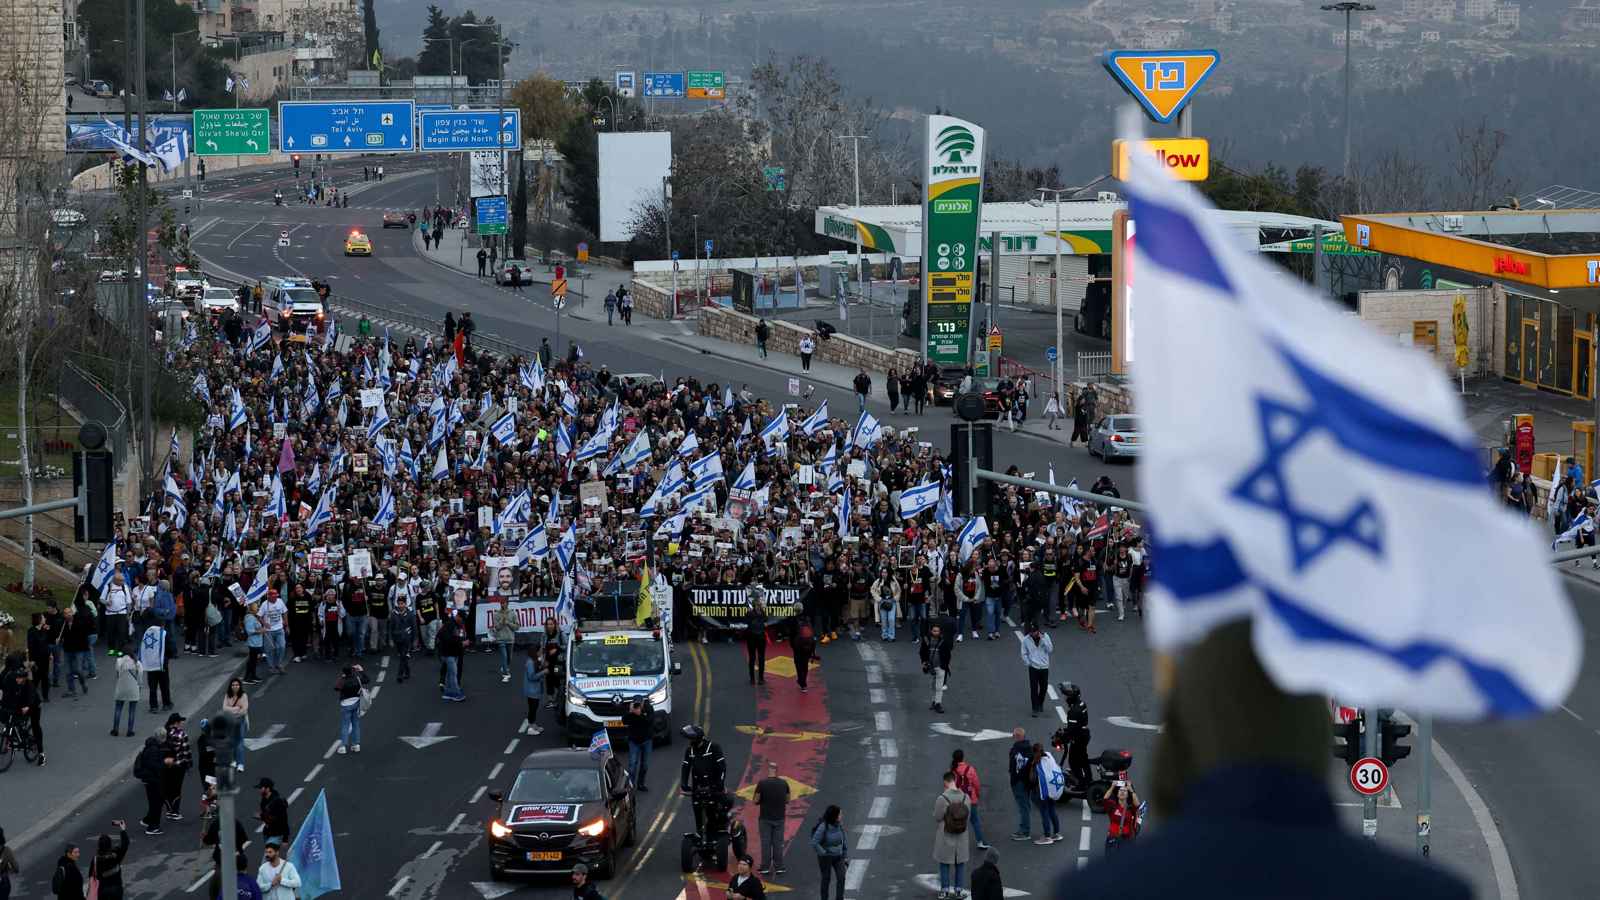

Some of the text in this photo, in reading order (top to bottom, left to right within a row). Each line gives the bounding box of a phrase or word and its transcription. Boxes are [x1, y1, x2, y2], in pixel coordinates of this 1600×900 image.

[1142, 61, 1185, 90] פז
[427, 136, 449, 144] Begin
[471, 135, 493, 143] North
[932, 164, 978, 175] דור אלון
[938, 201, 969, 211] אלונית
[1001, 236, 1037, 250] דור
[691, 589, 719, 604] ביחד
[763, 589, 800, 604] ישראל
[692, 605, 728, 617] החטופים
[1359, 769, 1381, 784] 30
